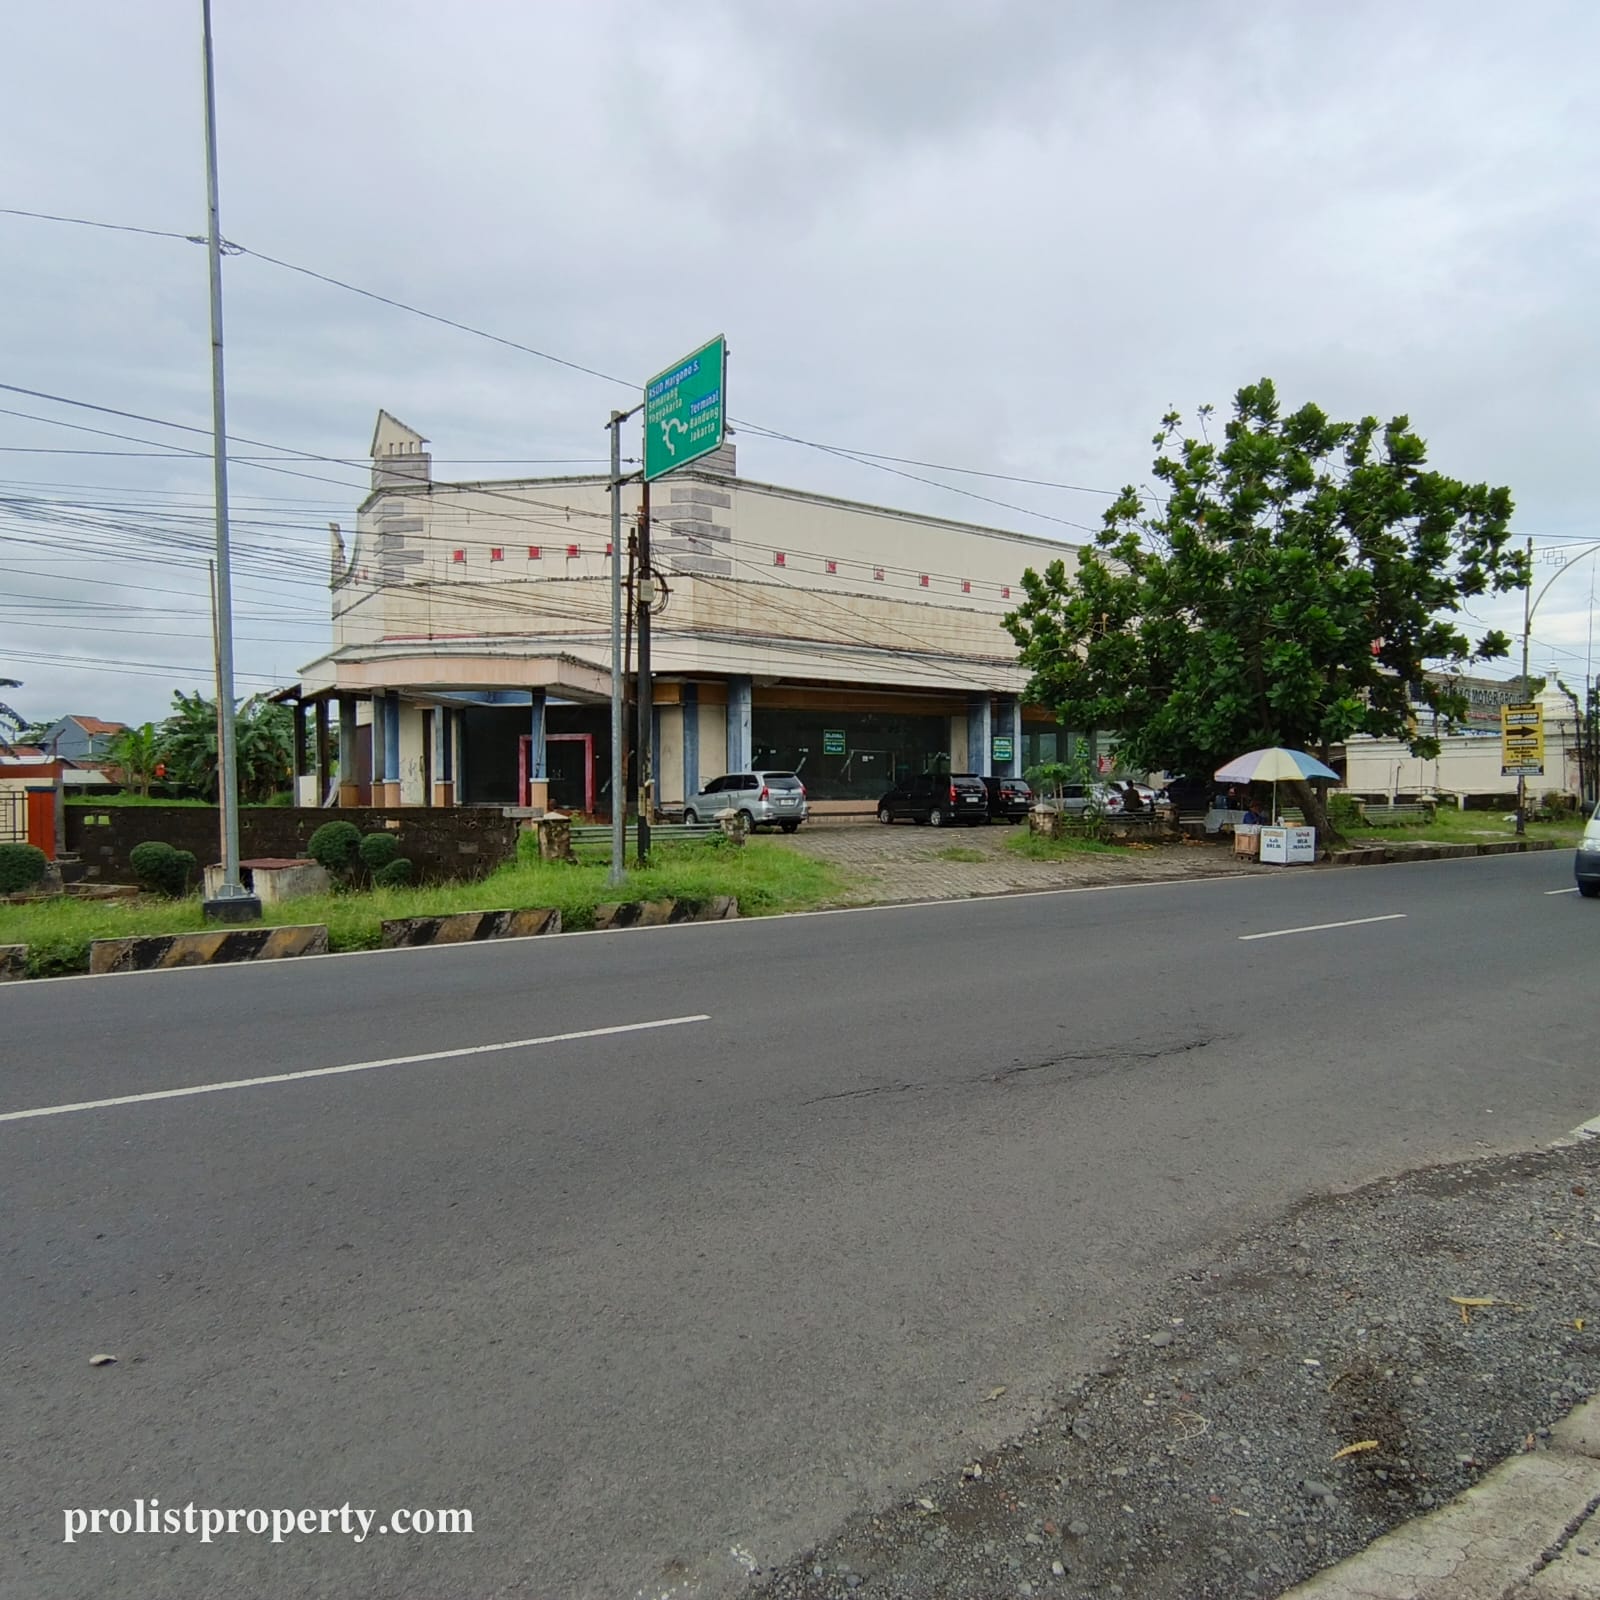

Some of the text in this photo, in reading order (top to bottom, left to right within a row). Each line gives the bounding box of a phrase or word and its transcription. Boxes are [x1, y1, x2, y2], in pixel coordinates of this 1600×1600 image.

[648, 382, 664, 398] RSUD
[665, 366, 692, 387] Margono
[648, 387, 678, 412] Semarang
[648, 398, 683, 424] Yogyakarta
[690, 390, 719, 415] Terminal
[690, 406, 719, 429] Bandung
[690, 422, 716, 442] Jakarta
[1471, 688, 1498, 705] MOTOR
